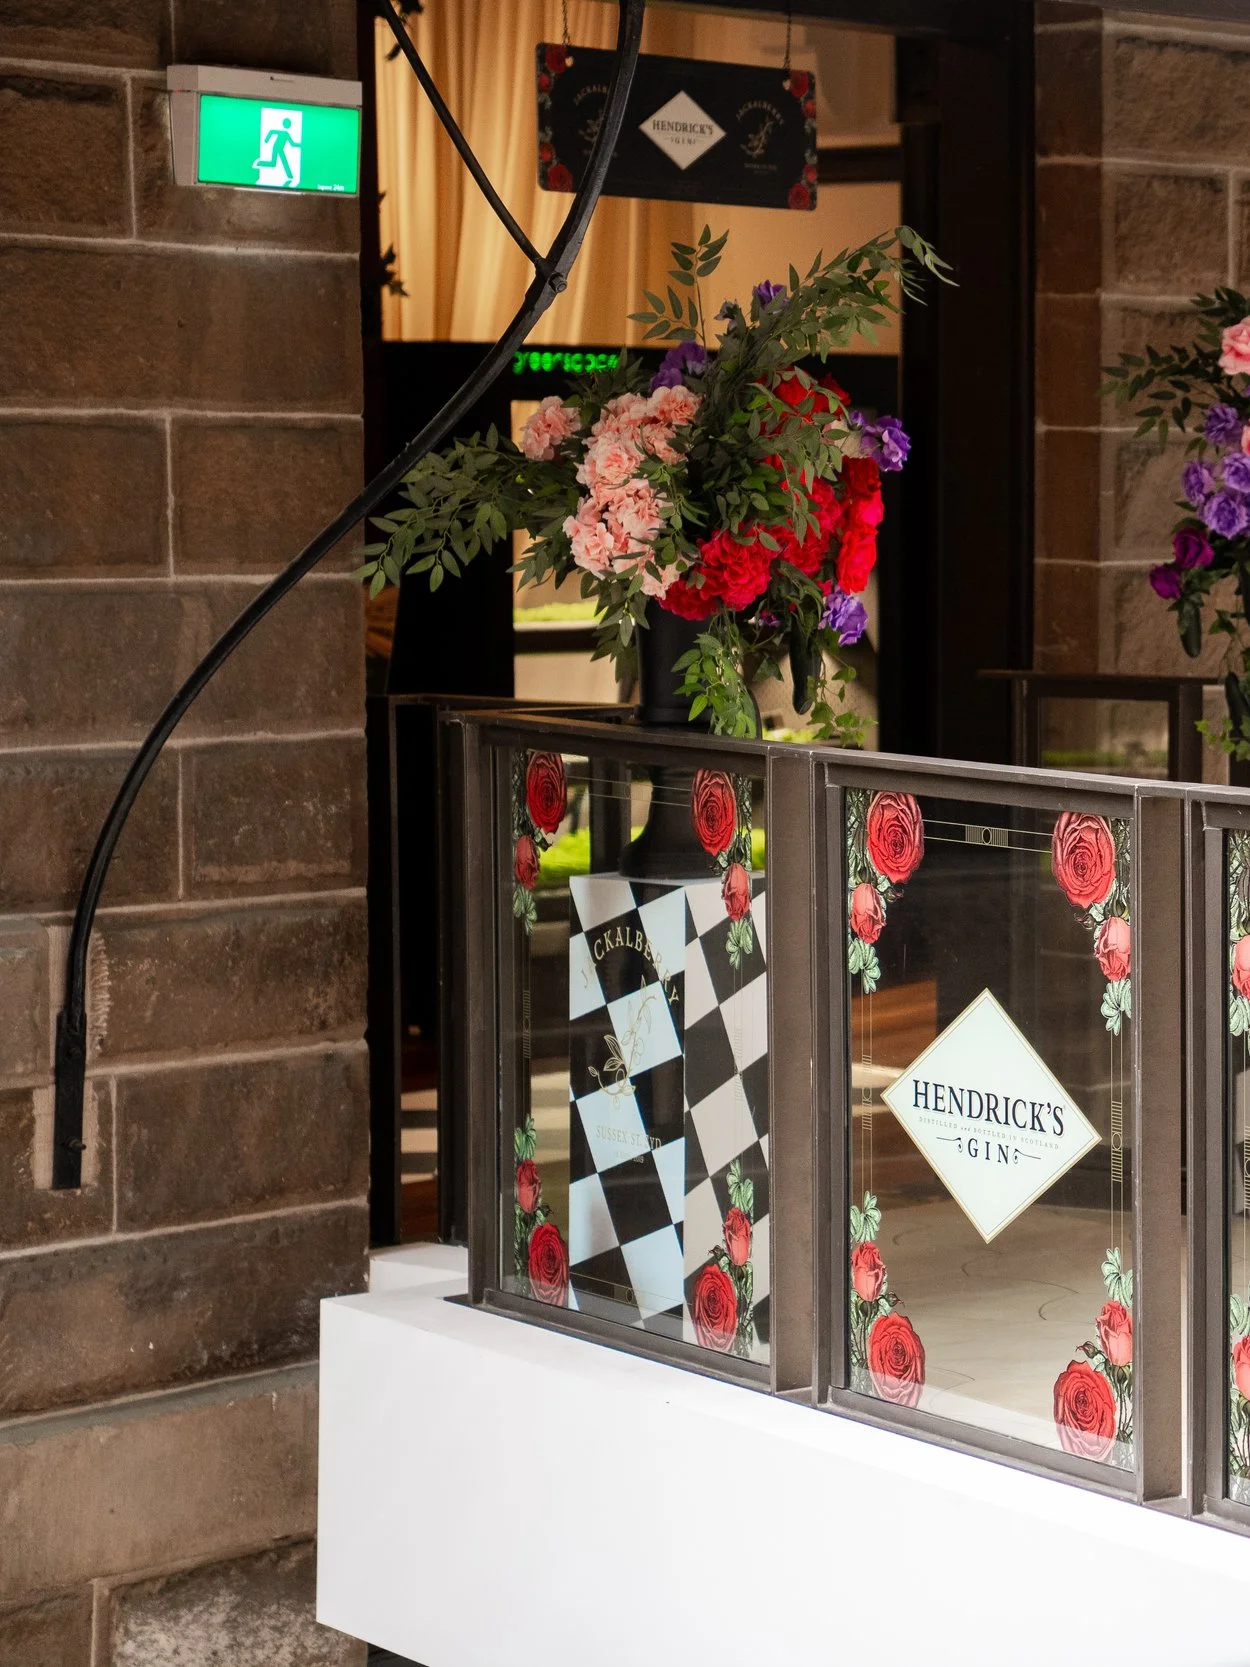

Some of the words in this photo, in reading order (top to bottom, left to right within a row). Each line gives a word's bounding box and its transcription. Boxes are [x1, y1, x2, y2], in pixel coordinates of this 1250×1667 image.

[652, 119, 713, 135] HENDRICK'S
[674, 137, 692, 145] GIN
[581, 927, 679, 1004] JACKALBERRY
[912, 1079, 1065, 1136] HENDRICK'S
[596, 1125, 628, 1144] SUSSEX
[967, 1138, 1010, 1164] GIN
